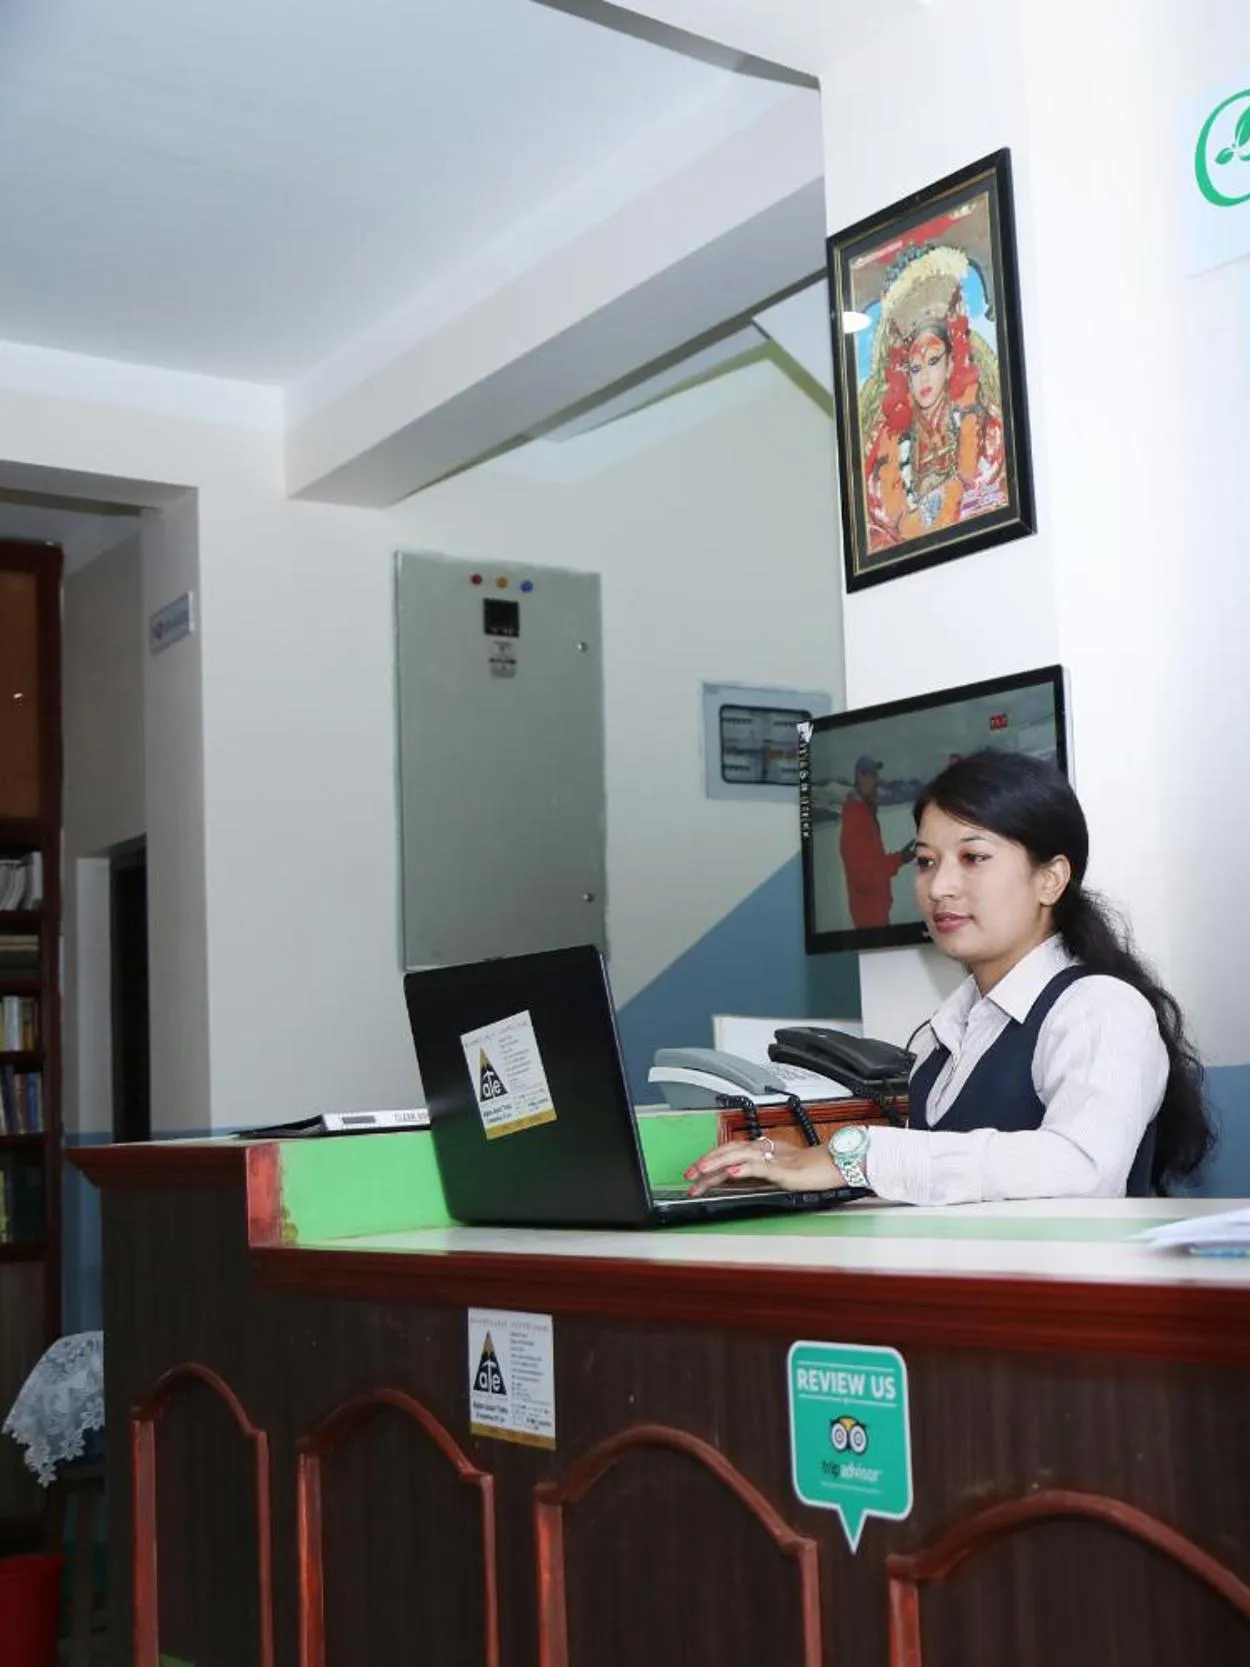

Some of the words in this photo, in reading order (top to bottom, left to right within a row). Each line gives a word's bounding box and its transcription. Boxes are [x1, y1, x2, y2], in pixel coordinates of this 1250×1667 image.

[797, 1369, 865, 1396] REVIEW
[871, 1375, 897, 1400] US
[822, 1459, 882, 1482] tripadvisor
